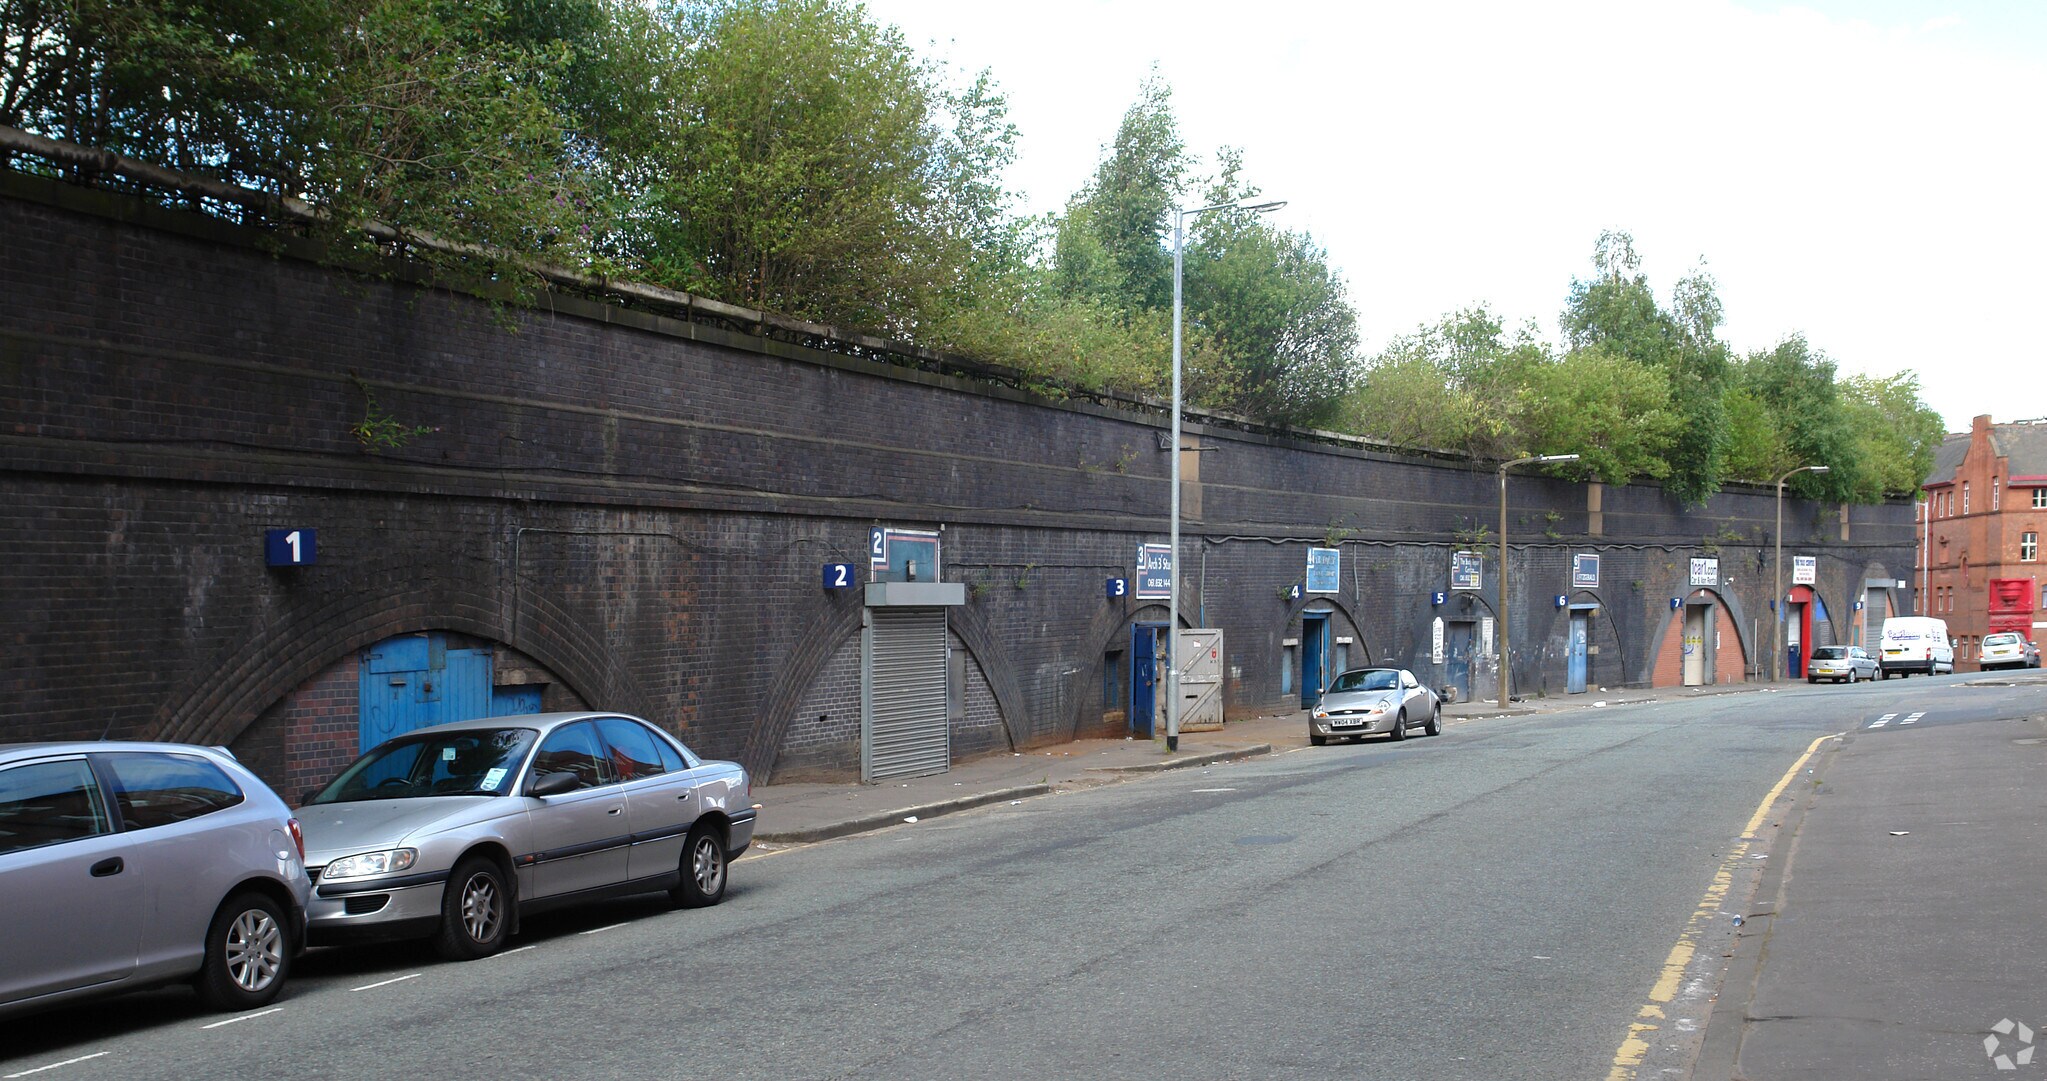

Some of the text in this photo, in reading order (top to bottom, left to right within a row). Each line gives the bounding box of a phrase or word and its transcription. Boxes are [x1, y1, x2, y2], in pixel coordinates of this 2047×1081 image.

[285, 531, 301, 562] 1
[873, 532, 882, 554] 2
[1138, 546, 1143, 563] 3
[1453, 553, 1457, 564] 5
[835, 565, 847, 586] 2
[1115, 579, 1124, 596] 3
[1292, 585, 1299, 598] 4
[1437, 593, 1444, 604] 5
[1559, 596, 1566, 606] 6
[1674, 598, 1680, 607] 7
